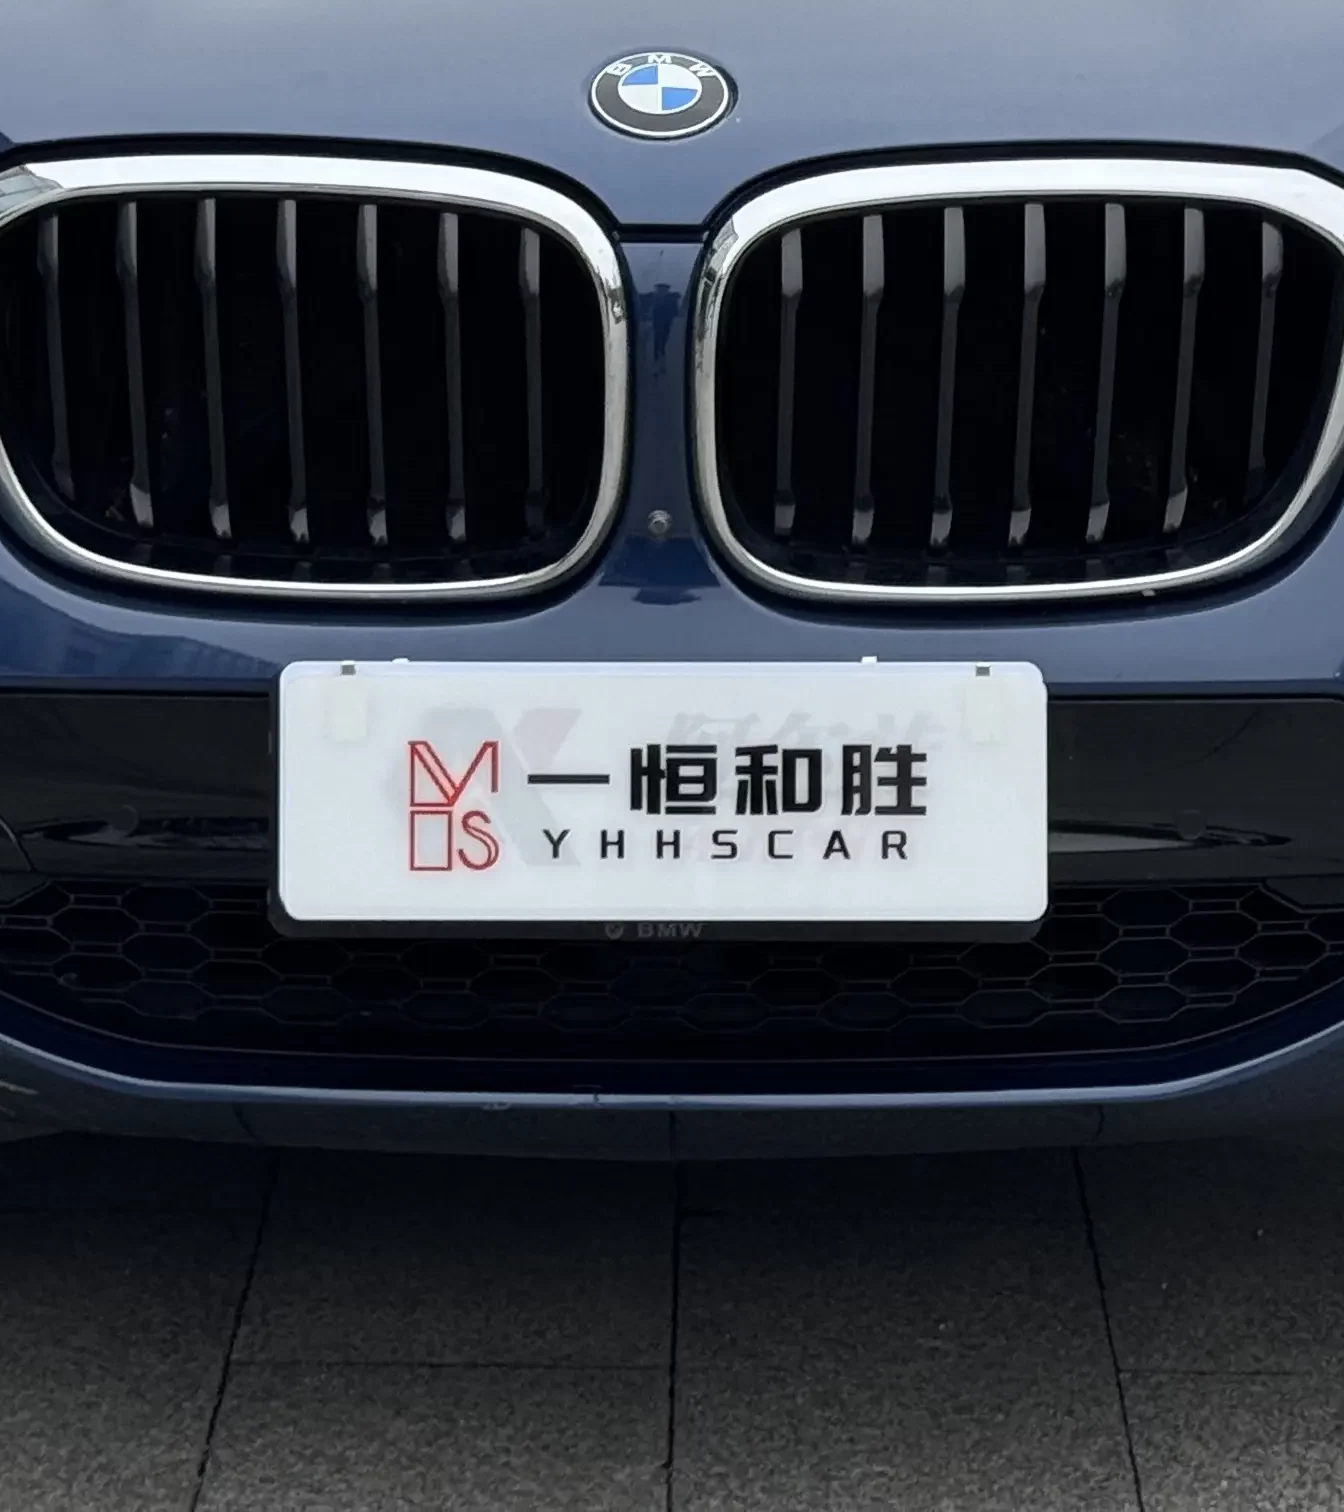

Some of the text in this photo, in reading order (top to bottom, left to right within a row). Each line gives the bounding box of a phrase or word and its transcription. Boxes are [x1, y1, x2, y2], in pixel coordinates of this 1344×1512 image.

[606, 53, 718, 77] BMW
[527, 744, 928, 816] 一恒和胜
[543, 829, 909, 860] YHHSCAR
[637, 922, 703, 939] BMW
